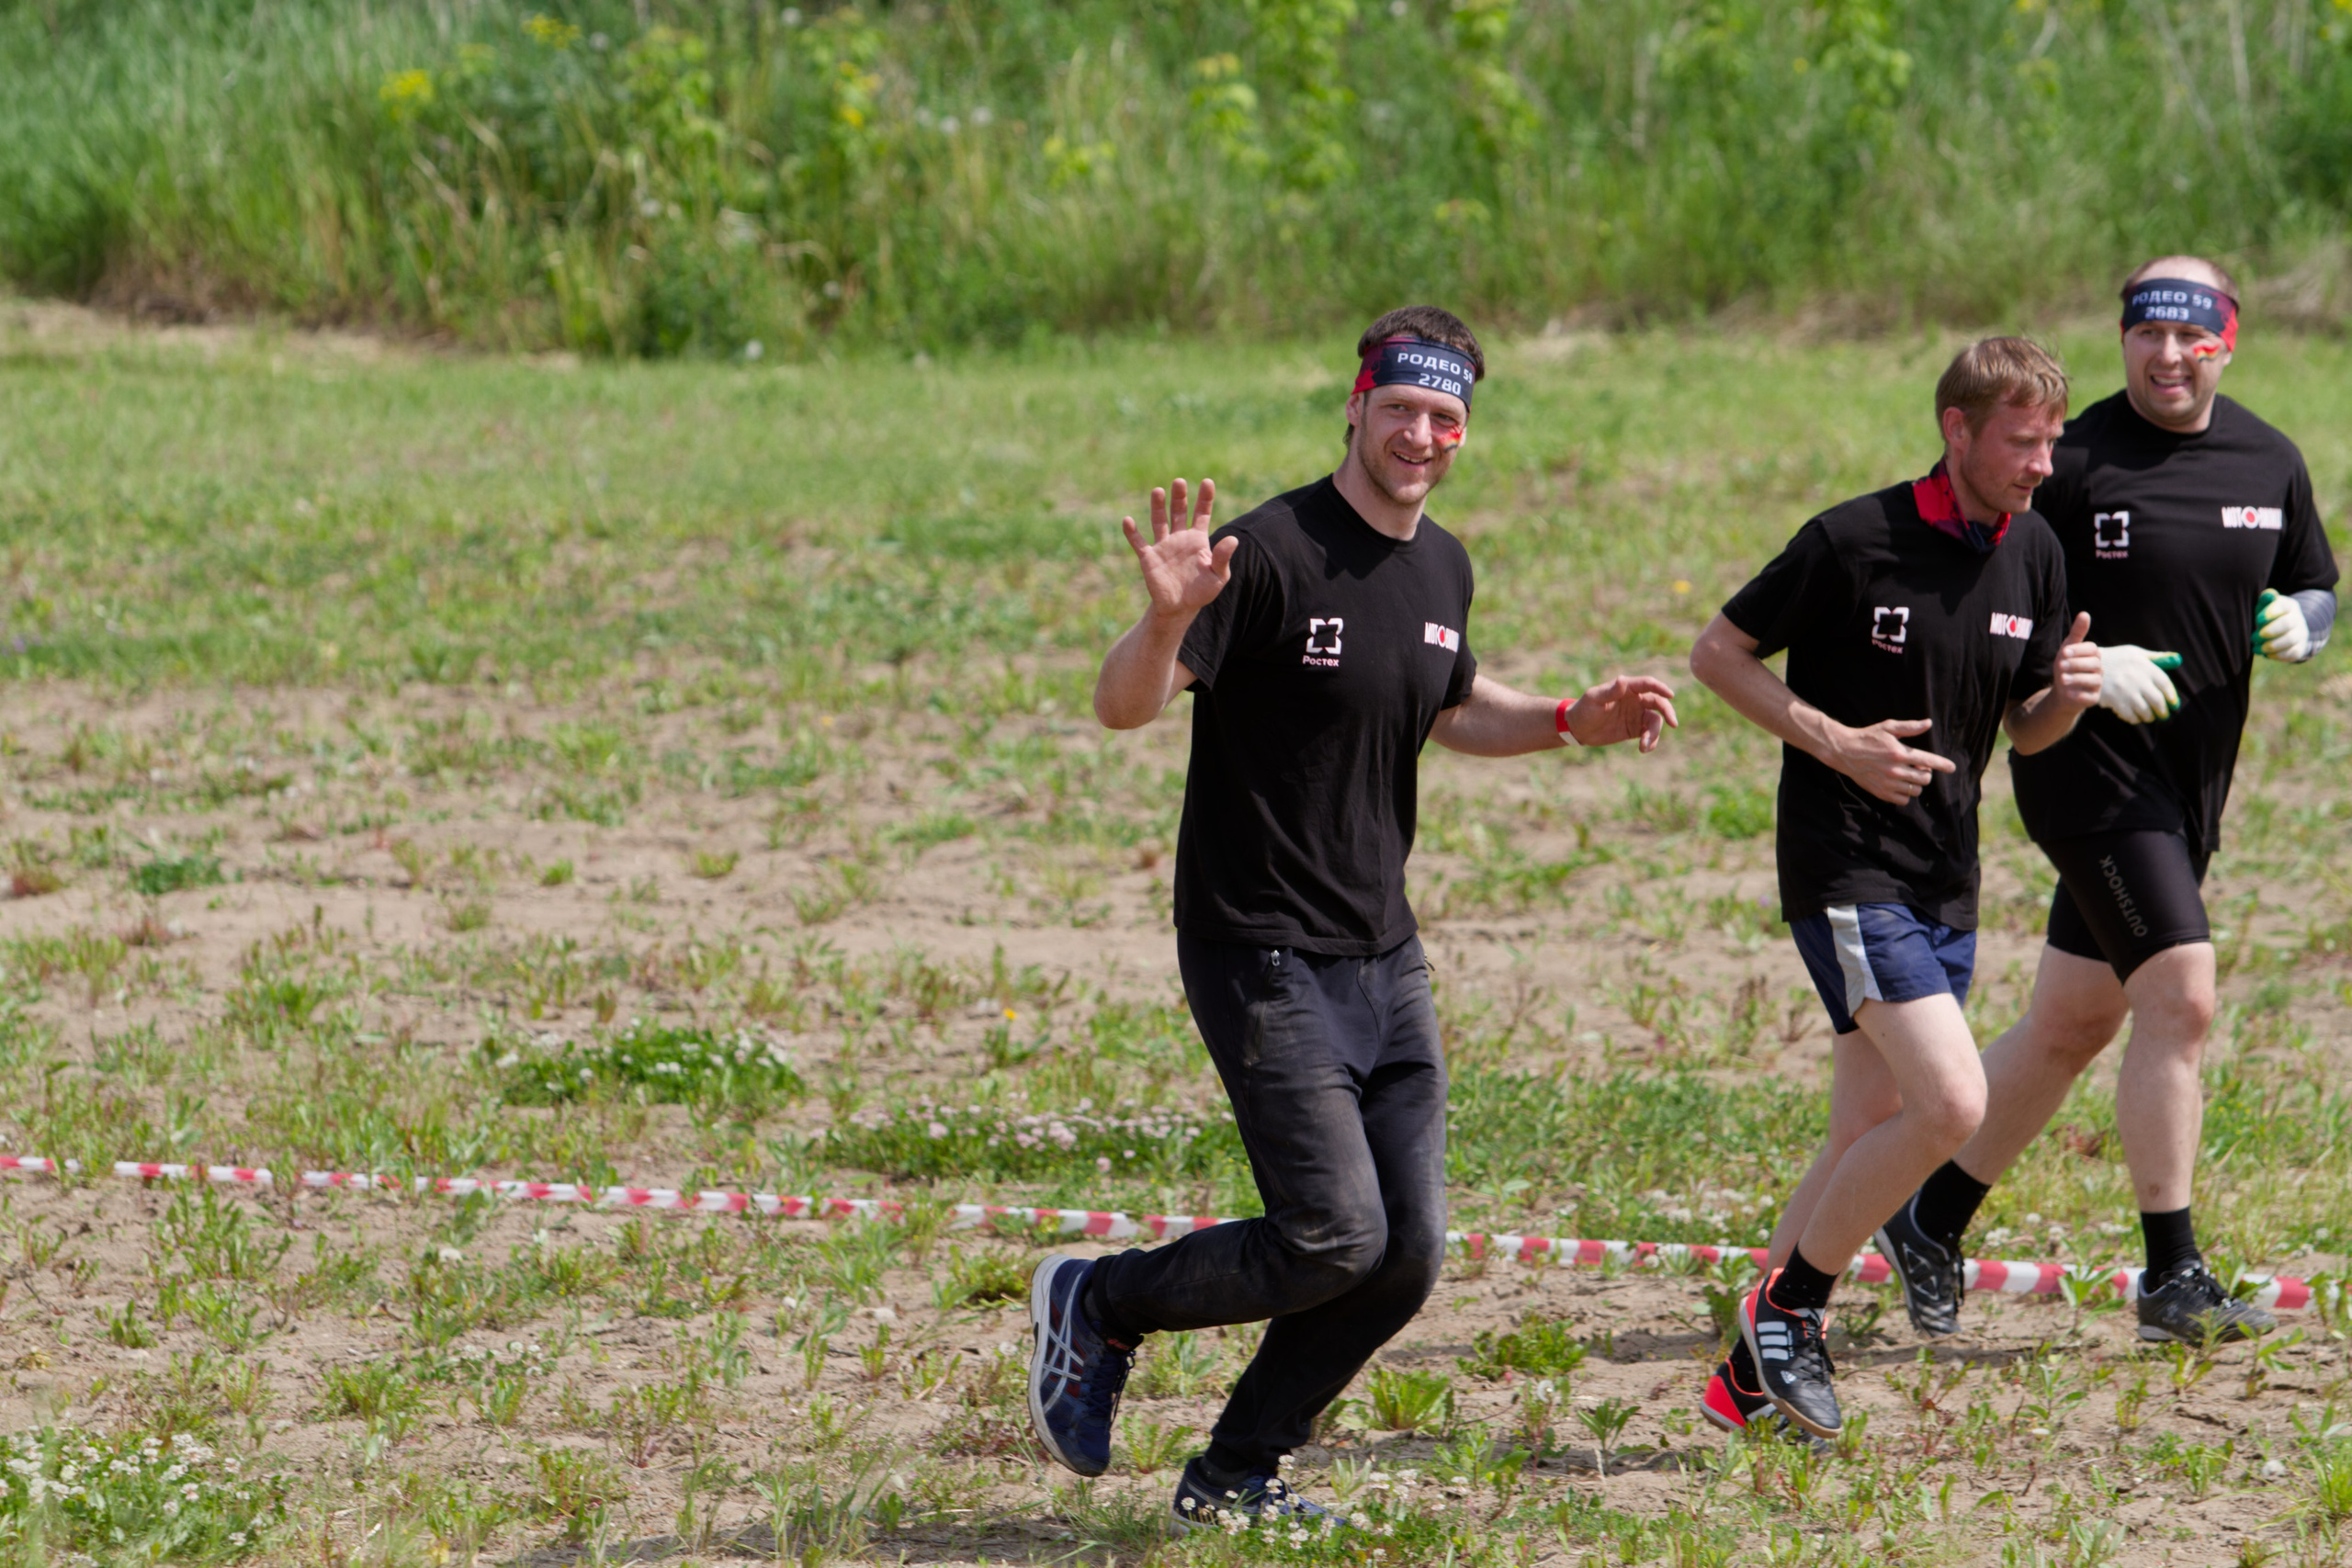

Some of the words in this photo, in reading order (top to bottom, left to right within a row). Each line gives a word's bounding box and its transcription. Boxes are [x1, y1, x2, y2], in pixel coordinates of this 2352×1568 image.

[2132, 290, 2188, 308] РОДЕО
[2192, 294, 2212, 310] 59
[1397, 353, 1461, 376] РОДЕО
[1418, 373, 1462, 396] 2780
[1302, 655, 1340, 667] Ростех
[2098, 854, 2148, 937] OUTSHOCK
